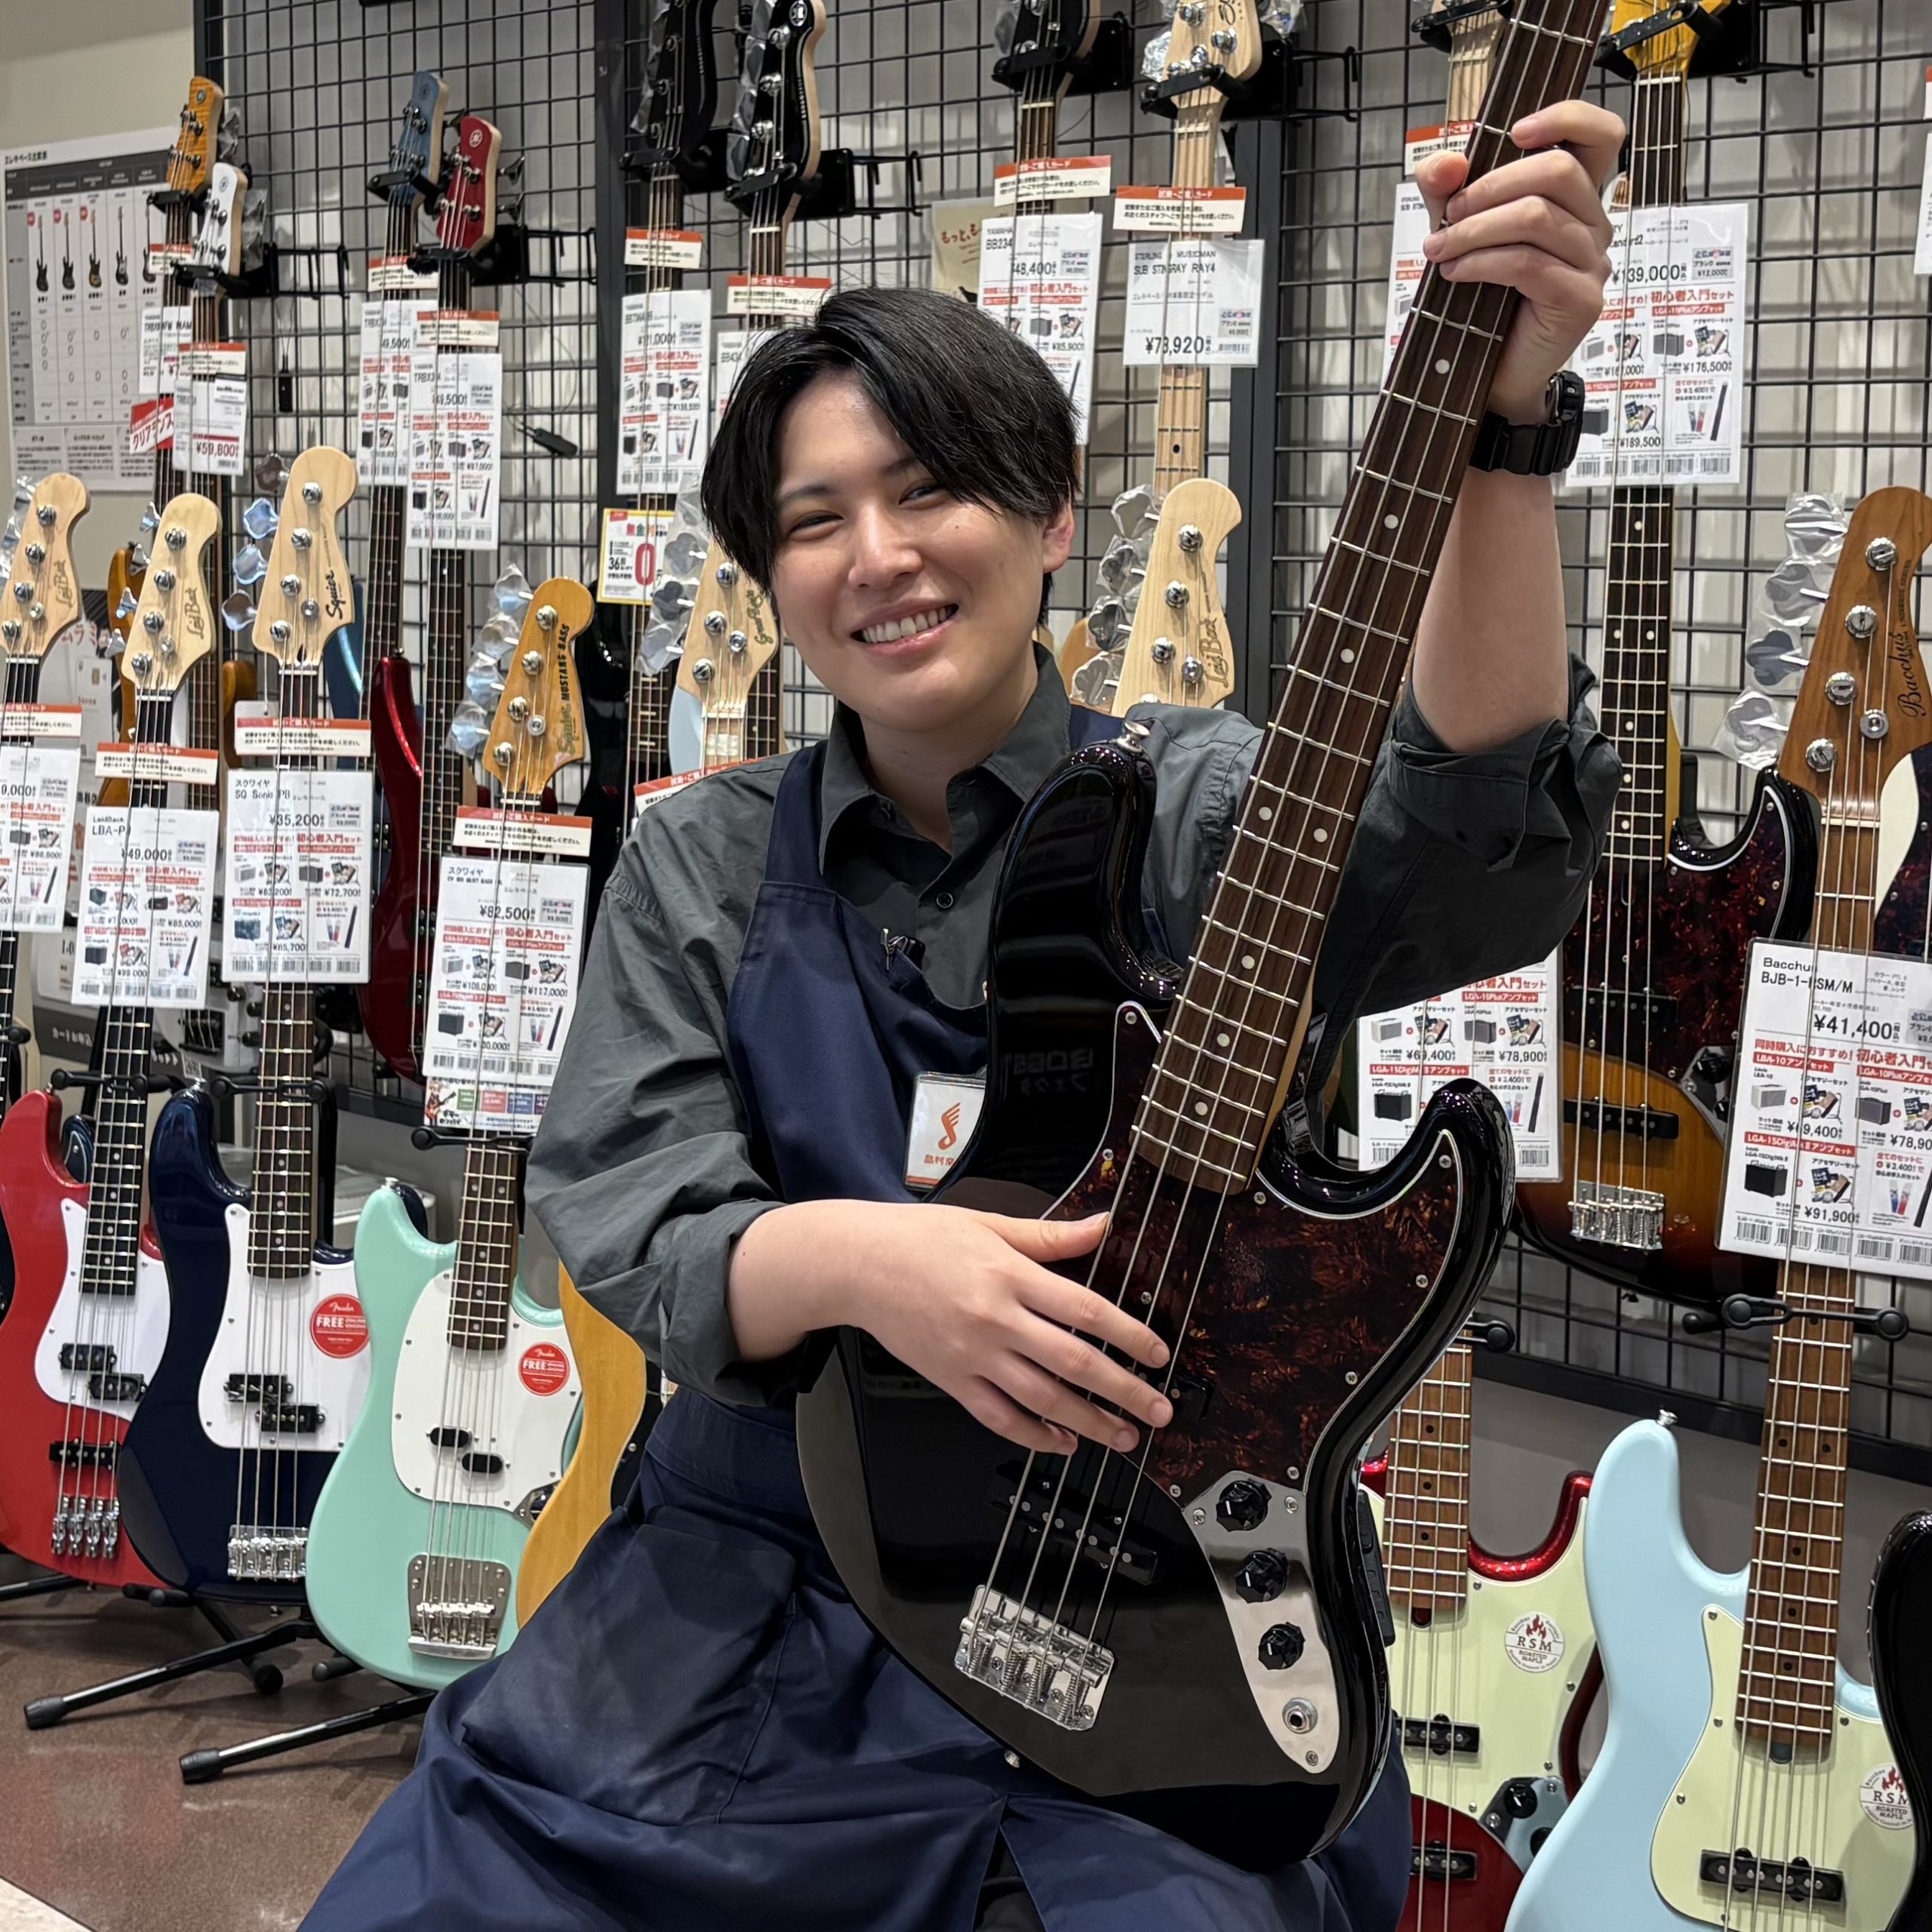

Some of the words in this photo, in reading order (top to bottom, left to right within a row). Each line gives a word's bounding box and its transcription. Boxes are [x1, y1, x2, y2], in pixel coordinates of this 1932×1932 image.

[1683, 361, 1728, 374] ¥176,500
[325, 570, 346, 620] Squier
[558, 623, 571, 651] BASS
[558, 654, 571, 701] MUSTANG
[1888, 632, 1927, 717] Bacchus
[235, 779, 270, 788] スクワイヤ
[235, 789, 247, 799] SQ
[269, 814, 320, 827] ¥35,200
[92, 825, 131, 836] LBA-P
[479, 905, 529, 921] ¥82,500
[1814, 1014, 1893, 1041] ¥41,400
[1499, 1051, 1543, 1063] ¥78,900
[1804, 1206, 1856, 1224] ¥91,900
[316, 1316, 345, 1328] FREE
[523, 1359, 549, 1371] FREE
[1517, 1635, 1552, 1652] RSM
